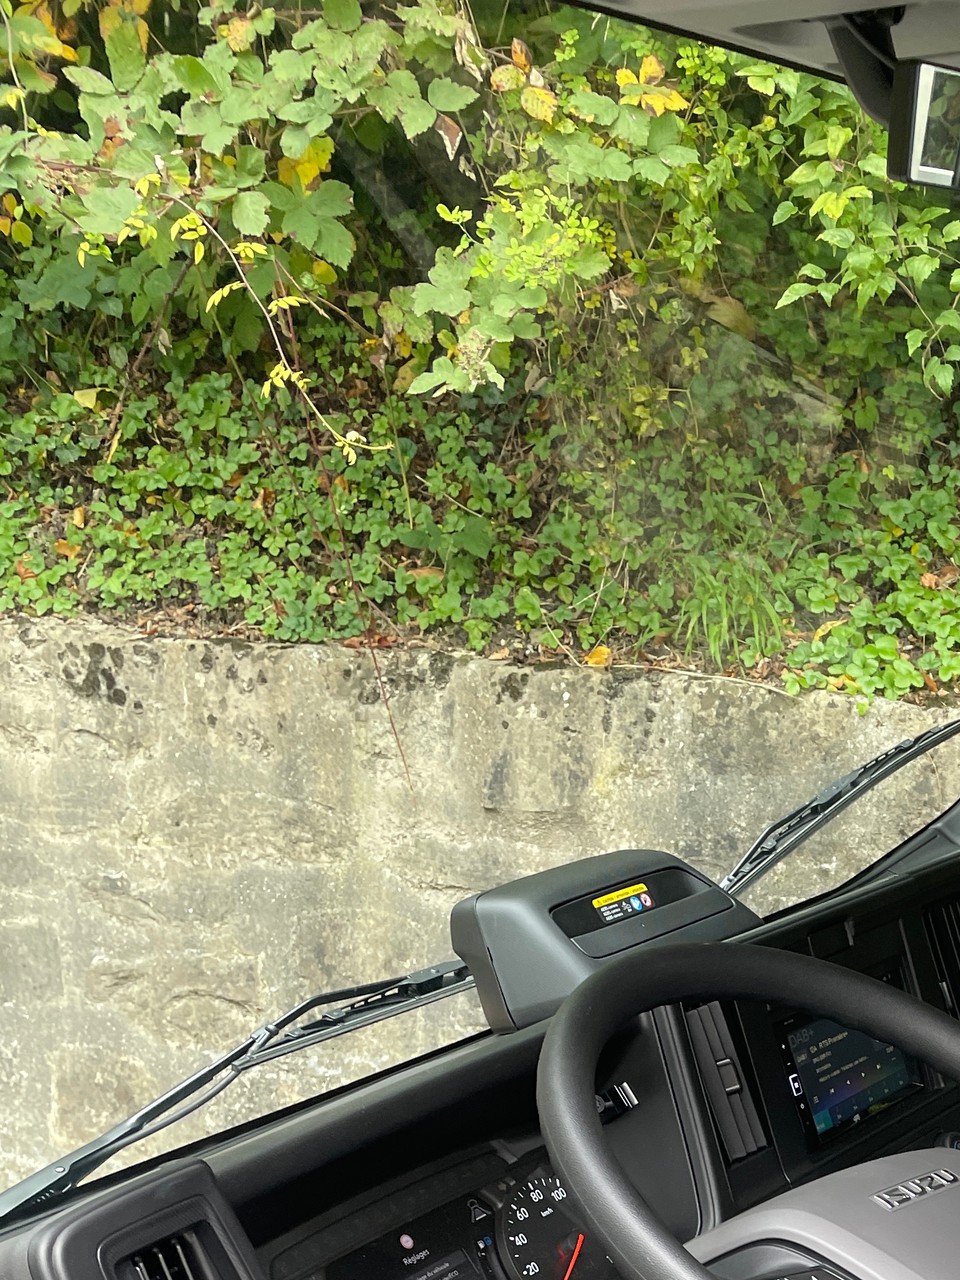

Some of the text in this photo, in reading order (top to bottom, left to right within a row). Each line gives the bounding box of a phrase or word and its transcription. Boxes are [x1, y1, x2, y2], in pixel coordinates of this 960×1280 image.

[789, 1029, 814, 1048] DAB+
[551, 1187, 567, 1202] 100
[873, 1168, 960, 1209] ISUZU
[530, 1189, 544, 1203] 80
[516, 1207, 529, 1221] 60
[540, 1207, 554, 1217] km/h
[514, 1233, 528, 1246] 40
[526, 1261, 540, 1276] 20
